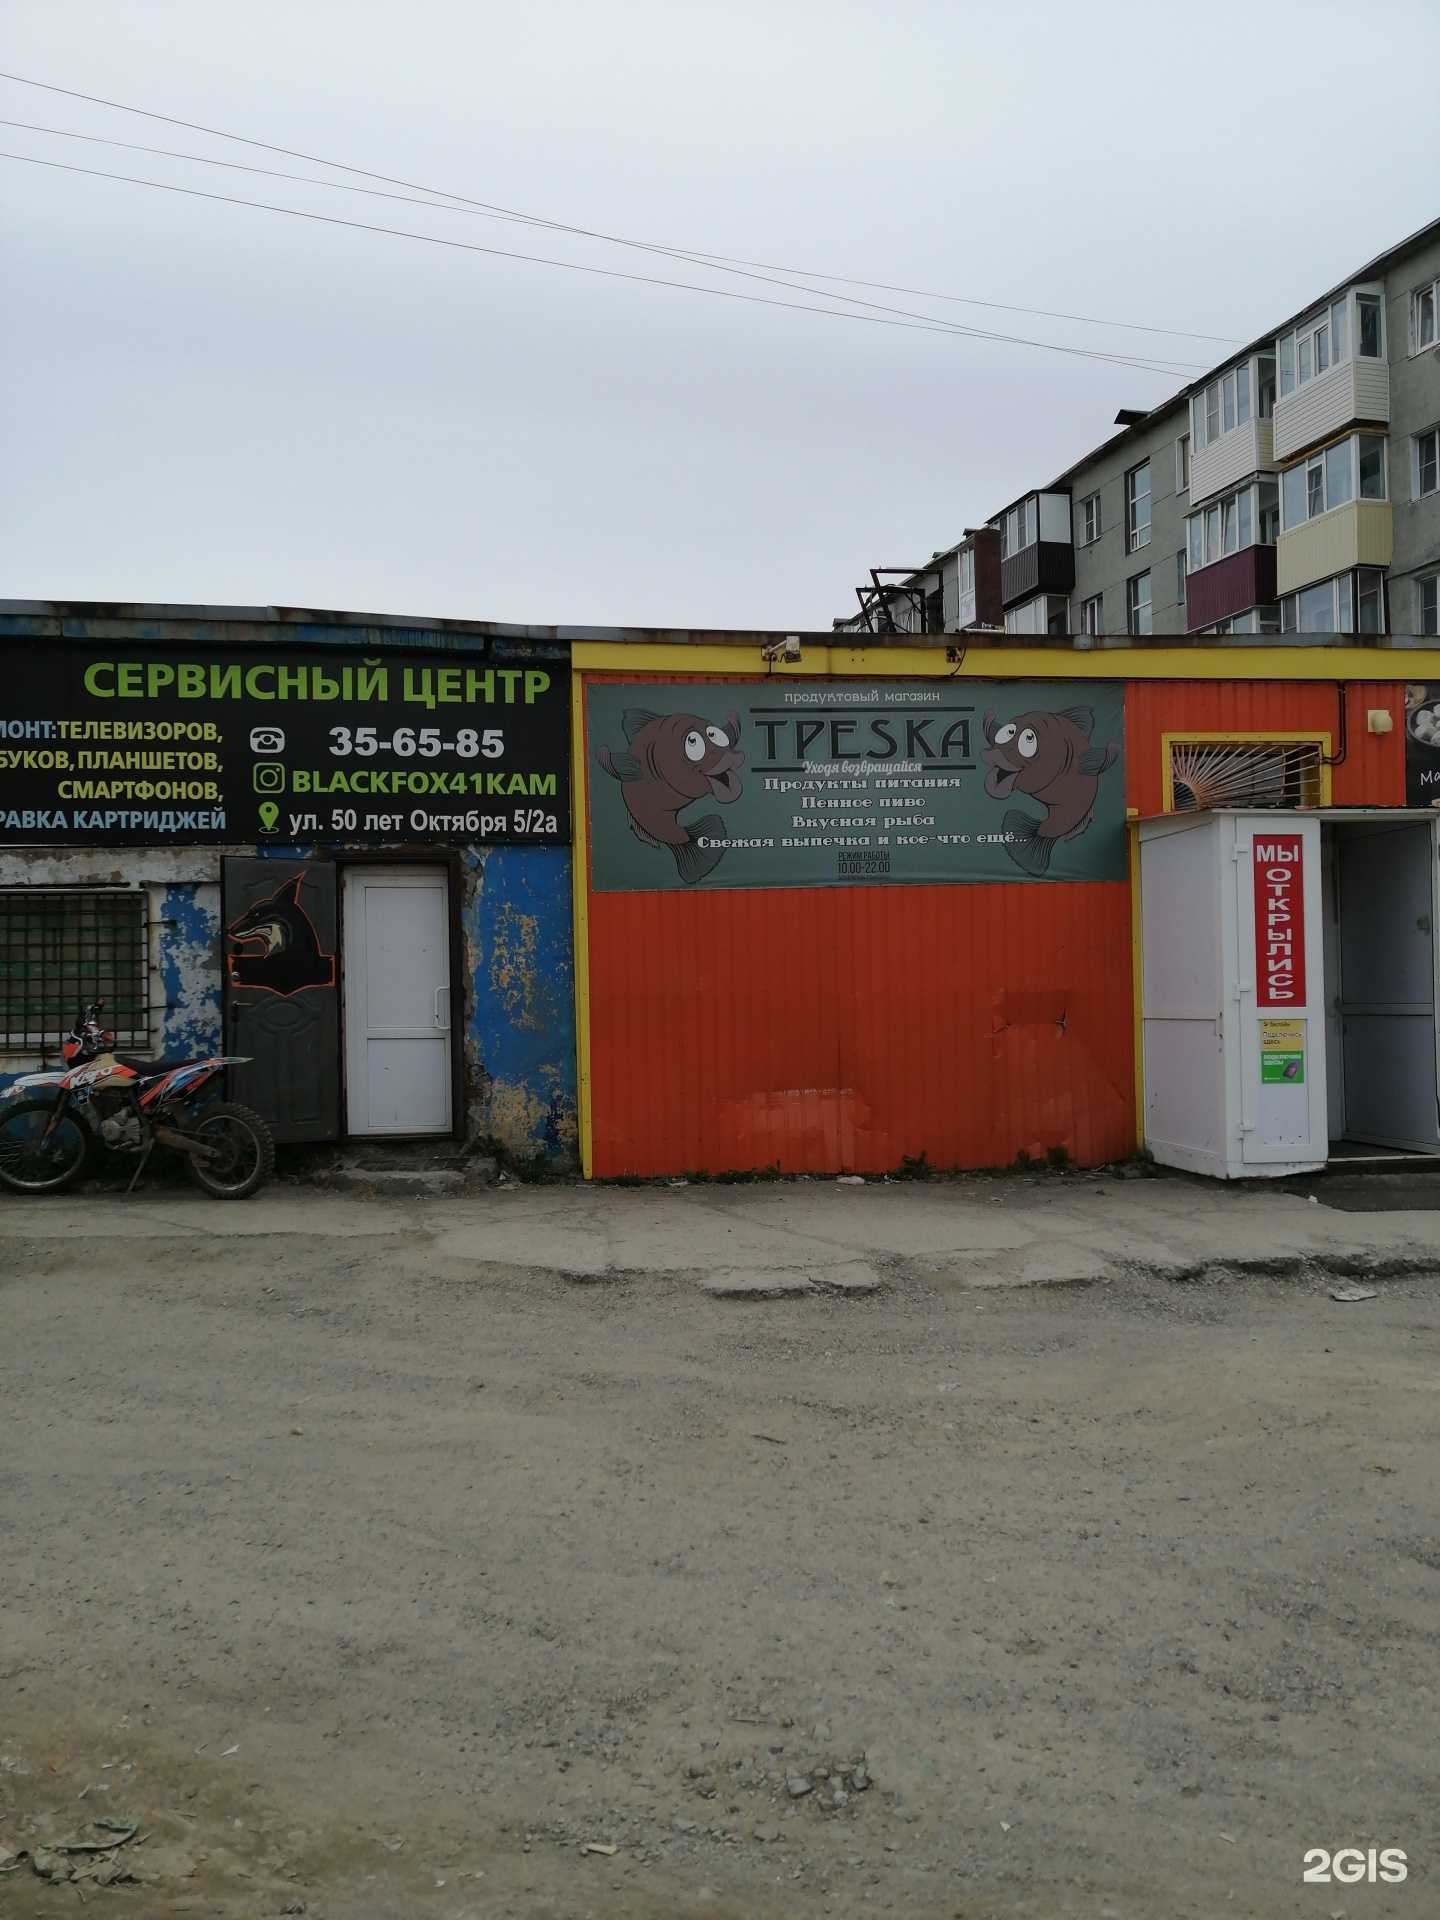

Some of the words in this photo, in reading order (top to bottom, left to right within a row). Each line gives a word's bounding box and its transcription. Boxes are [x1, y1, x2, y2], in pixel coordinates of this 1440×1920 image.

[83, 657, 389, 701] СЕРВИСНЫЙ
[402, 667, 551, 709] ЦЕНТР
[784, 690, 879, 704] продуктовый
[884, 692, 941, 702] магазин
[328, 726, 505, 758] 35-65-85
[78, 752, 224, 773] ПЛАНШЕТОВ,
[802, 760, 840, 777] Уходя
[57, 781, 224, 802] СМАРТФОНОВ,
[292, 771, 557, 796] BLACKFOX41KAM
[764, 778, 867, 792] Продукты
[875, 778, 961, 789] питания
[801, 796, 873, 809] Пенное
[879, 798, 926, 808] пиво
[74, 807, 226, 833] КАРТРИДЖЕЙ
[289, 812, 324, 835] ул.
[331, 809, 356, 831] 50
[363, 813, 403, 831] лет
[410, 809, 507, 836] Октября
[513, 809, 558, 833] 5/2а
[791, 815, 876, 829] Вкусная
[884, 815, 935, 828] рыба
[697, 836, 774, 849] Свежая
[781, 837, 870, 848] выпечка
[878, 836, 889, 845] и
[896, 834, 971, 845] кое-что
[1256, 844, 1299, 863] МЫ
[1266, 868, 1294, 1000] ОТКРЫЛИСЬ
